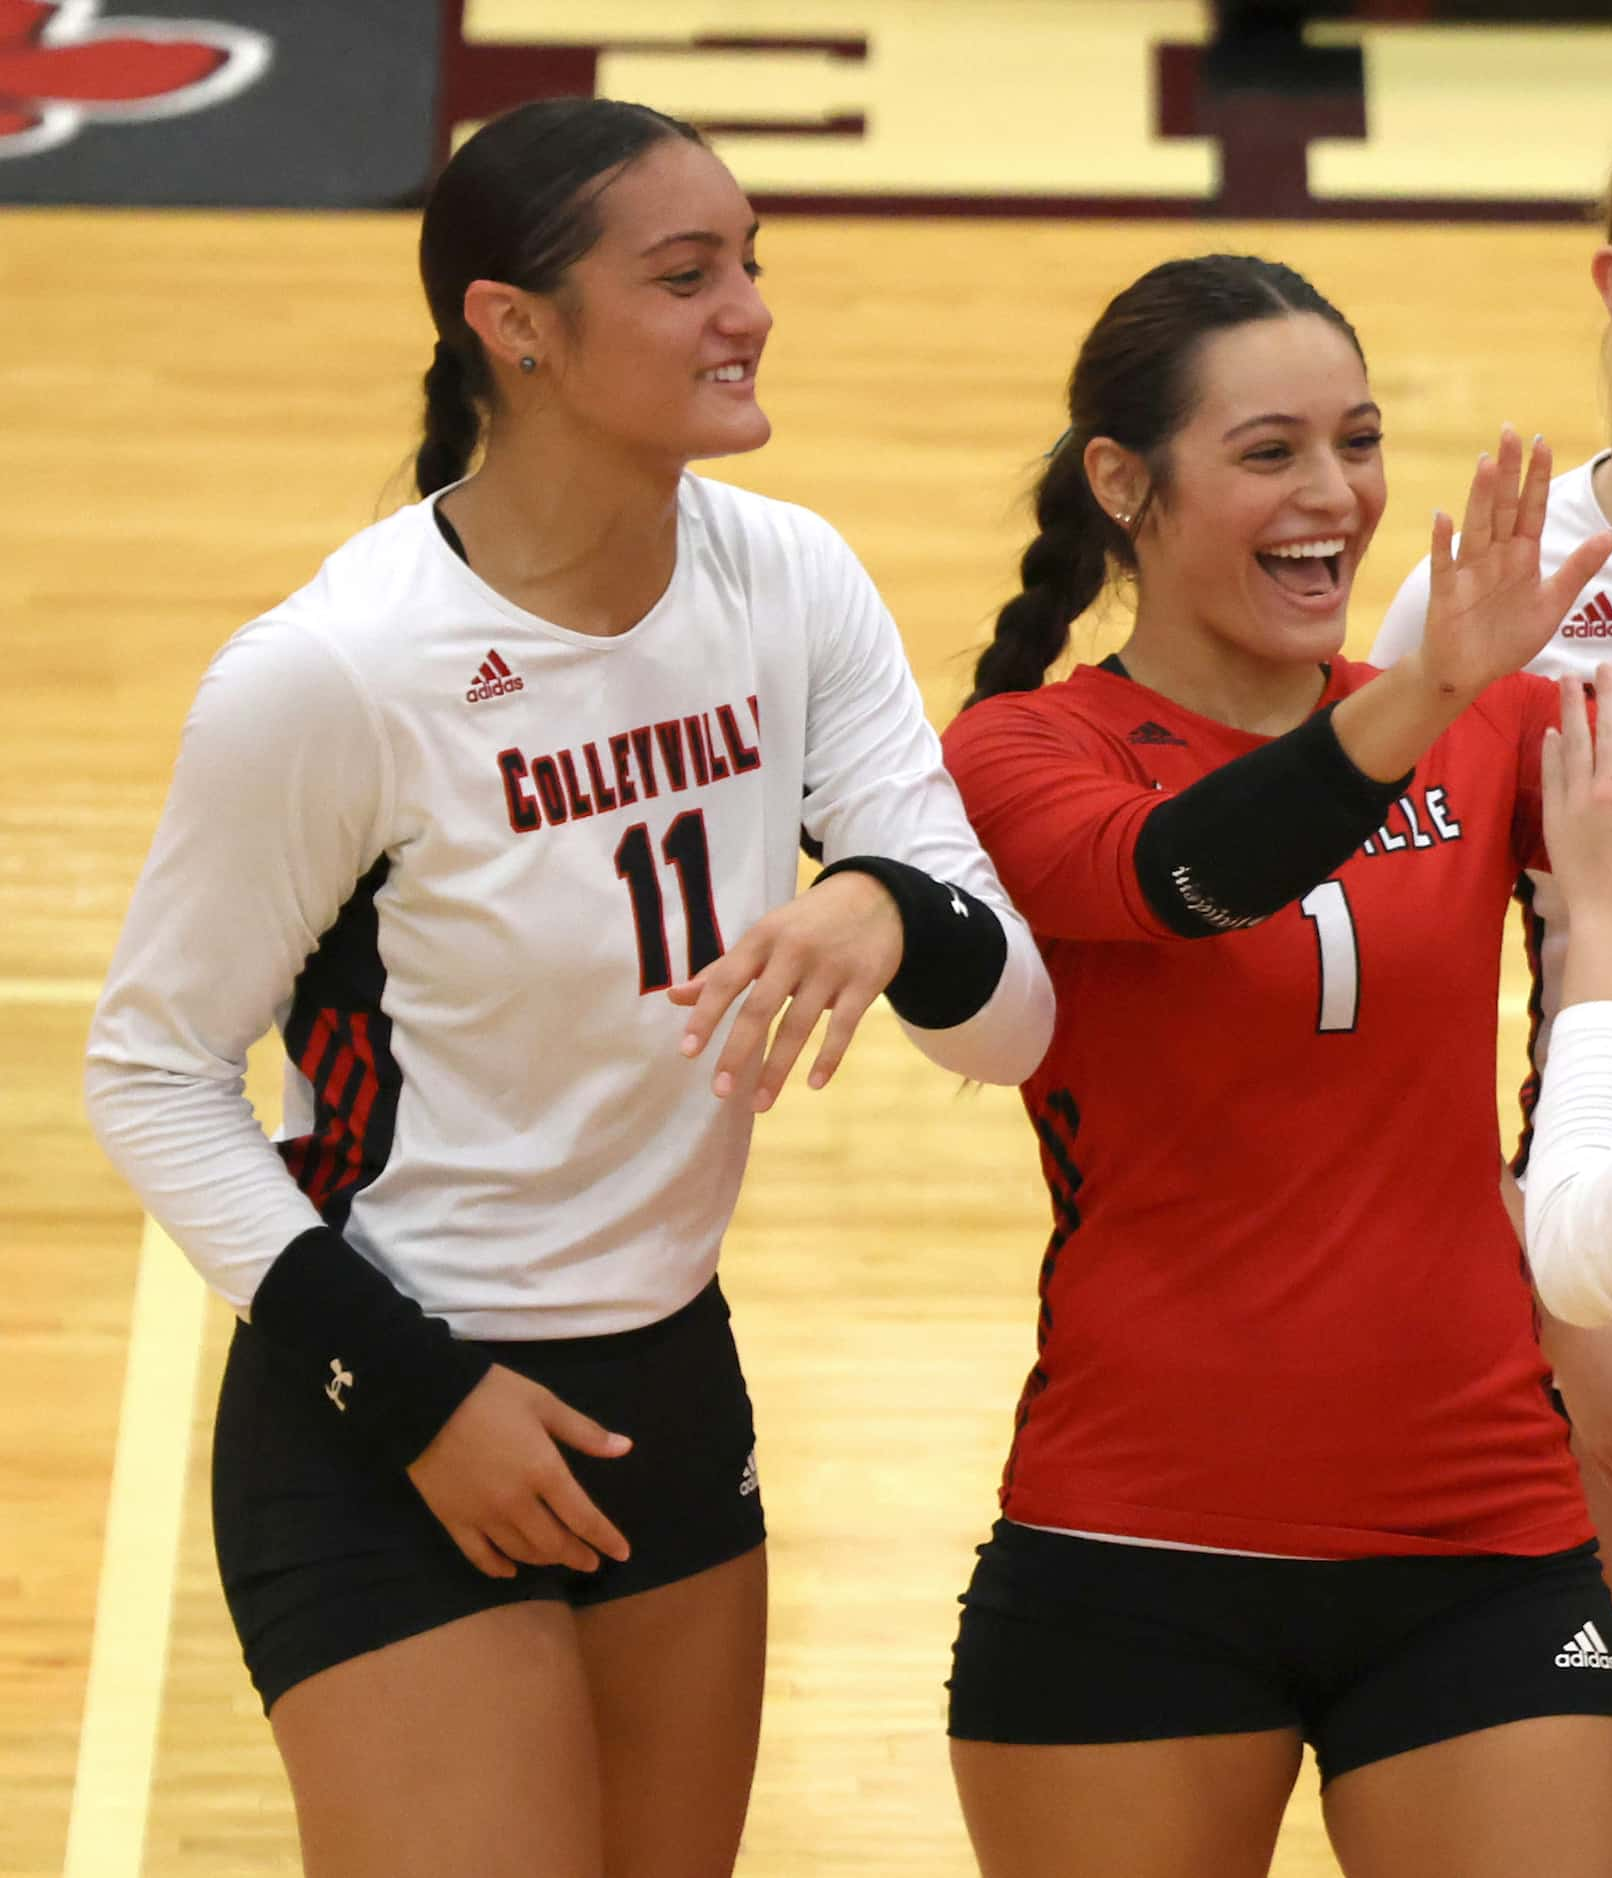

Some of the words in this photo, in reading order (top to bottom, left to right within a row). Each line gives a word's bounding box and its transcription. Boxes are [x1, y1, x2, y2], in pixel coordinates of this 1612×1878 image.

[466, 677, 523, 703] adidas
[497, 695, 761, 834] COLLEYVILL
[614, 808, 725, 996] 11
[1300, 878, 1361, 1034] 1
